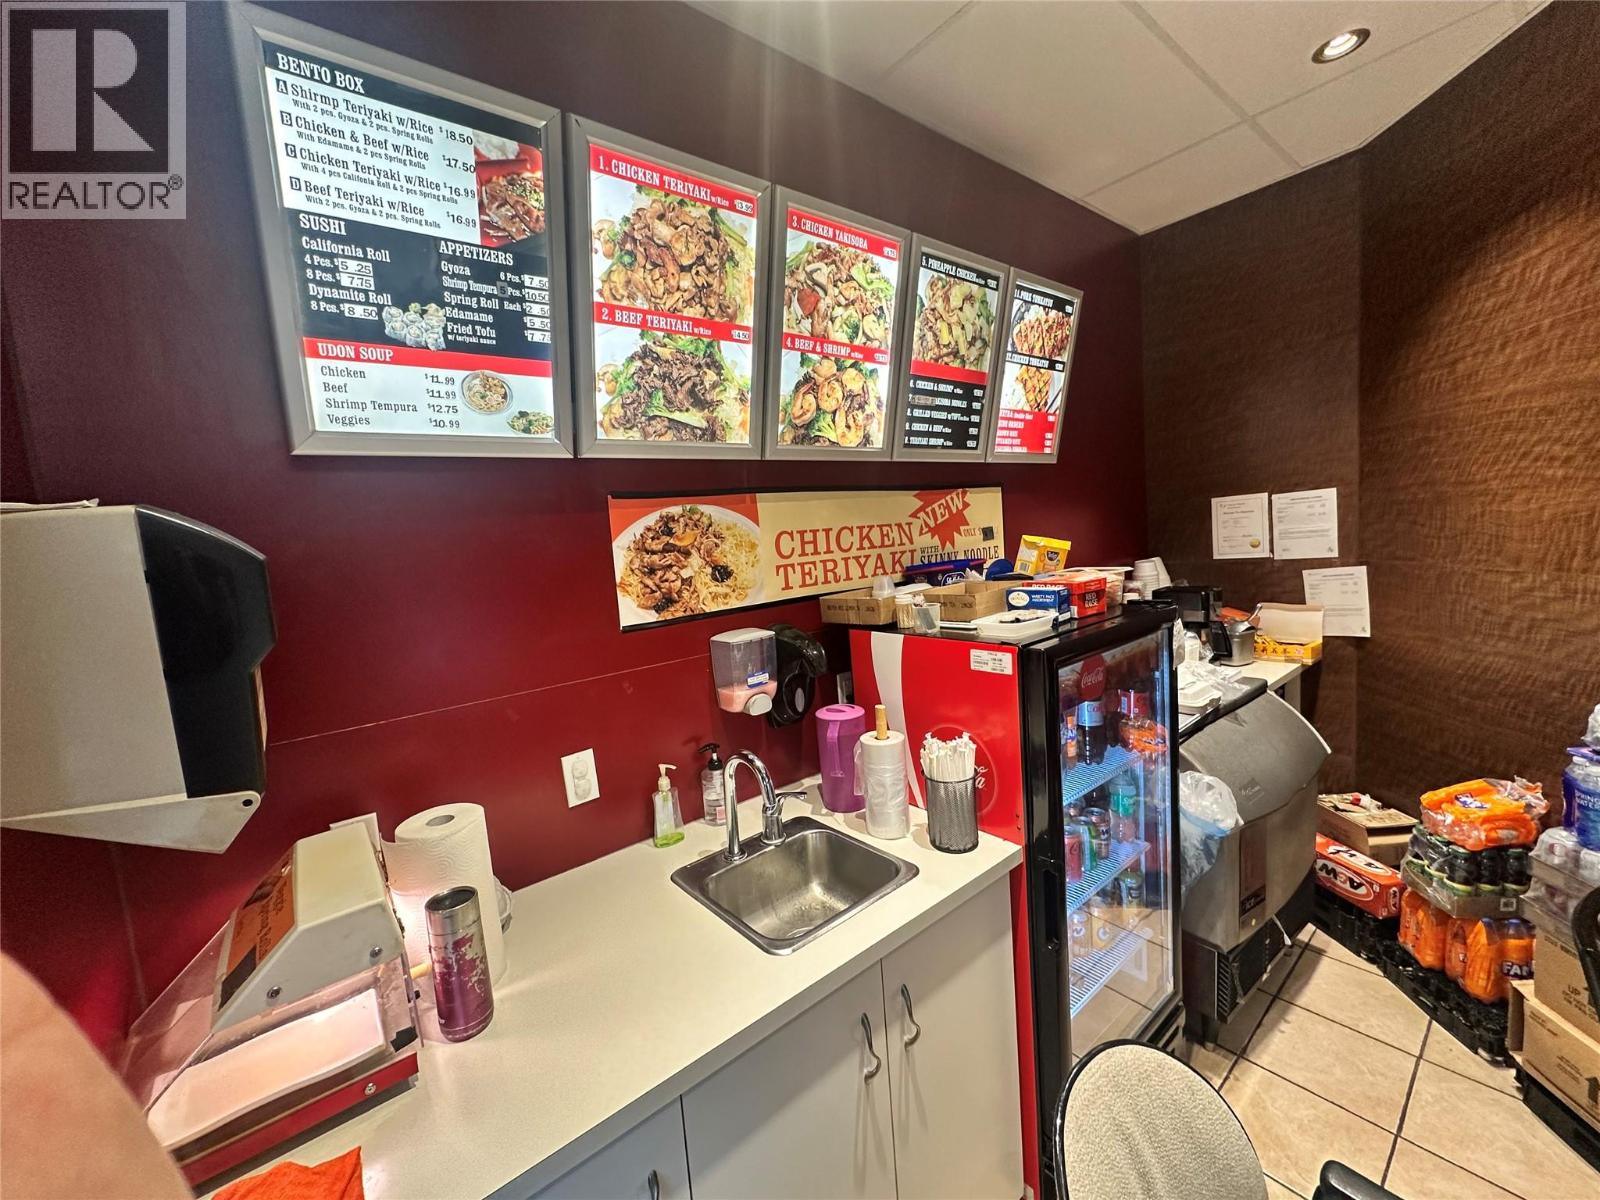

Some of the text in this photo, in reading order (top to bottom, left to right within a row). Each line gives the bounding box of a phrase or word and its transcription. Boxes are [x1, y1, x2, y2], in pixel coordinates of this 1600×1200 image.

[276, 52, 365, 94] BENTO BOX
[277, 79, 288, 94] A
[291, 84, 339, 109] Shirmp
[343, 98, 393, 124] Teriyaki
[396, 115, 434, 135] w/Rice
[292, 98, 434, 145] With 2 pcs. Gyoza & 2 pcs. Spring Rolls
[281, 111, 292, 126] B
[295, 115, 346, 140] Chicken
[350, 131, 360, 144] &
[362, 133, 388, 151] Beef
[391, 142, 429, 162] w/Rice
[296, 130, 316, 143] With
[317, 136, 354, 152] Edamame
[355, 146, 362, 154] &
[363, 147, 369, 155] 2
[384, 152, 407, 168] Spring
[408, 160, 426, 171] Rolls
[286, 144, 296, 158] C
[299, 147, 349, 170] Chicken
[352, 160, 401, 183] Teriyaki
[404, 174, 441, 191] w/Rice
[599, 155, 609, 171] 1.
[611, 159, 660, 187] CHICKEN
[662, 175, 711, 202] TERIYAKI
[300, 162, 320, 173] With
[321, 166, 327, 174] 4
[377, 179, 391, 190] Roll
[392, 183, 399, 191] &
[418, 189, 441, 202] Spring
[441, 194, 458, 205] Rolls
[290, 177, 301, 191] D
[304, 179, 331, 197] Beef
[334, 186, 384, 208] Teriyaki
[387, 200, 425, 217] w/Rice
[305, 194, 324, 206] With
[325, 198, 330, 207] 2
[349, 203, 370, 216] Gyoza
[371, 208, 377, 216] &
[378, 209, 384, 217] 2
[400, 214, 423, 226] Spring
[424, 219, 441, 229] Rolls
[299, 213, 347, 236] SUSHI
[801, 219, 834, 239] CHICKEN
[835, 229, 868, 249] YAKISOBA
[301, 235, 391, 263] California Roll
[439, 240, 513, 266] APPETIZERS
[304, 254, 311, 265] 4
[313, 255, 334, 268] Pcs.
[441, 261, 471, 276] Gyoza
[500, 271, 505, 280] 6
[507, 272, 521, 283] Pcs.
[928, 257, 956, 276] PINEAPPLE
[956, 267, 977, 283] CHICKEN
[306, 268, 313, 279] 8
[315, 270, 335, 283] Pcs.
[442, 276, 468, 292] Shrimp
[469, 280, 497, 294] Tempura
[507, 287, 522, 297] Pcs.
[308, 283, 392, 306] Dynamite Roll
[443, 291, 478, 308] Spring
[480, 297, 499, 310] Roll
[504, 301, 521, 312] Each
[310, 300, 318, 311] 8
[320, 301, 339, 313] Pcs.
[445, 307, 493, 323] Edamame
[447, 322, 472, 335] Fried
[475, 325, 496, 338] Tofu
[601, 307, 612, 321] 2.
[615, 310, 643, 325] BEEF
[646, 315, 693, 333] TERIYAKI
[456, 335, 479, 344] teriyaki
[794, 338, 815, 351] BEEF
[816, 343, 821, 352] &
[823, 343, 852, 357] SHRIMP
[317, 342, 394, 362] UDON SOUP
[320, 365, 366, 379] Chicken
[323, 382, 348, 393] Beef
[325, 397, 367, 411] Shrimp
[371, 400, 418, 413] Tempura
[327, 413, 370, 427] Veggies
[917, 489, 964, 533] NEW
[775, 521, 914, 560] CHICKEN
[920, 546, 940, 554] WITH
[920, 546, 1000, 565] SKINNY NOODLE
[776, 549, 917, 591] TERIYAKI
[1085, 592, 1097, 600] RED
